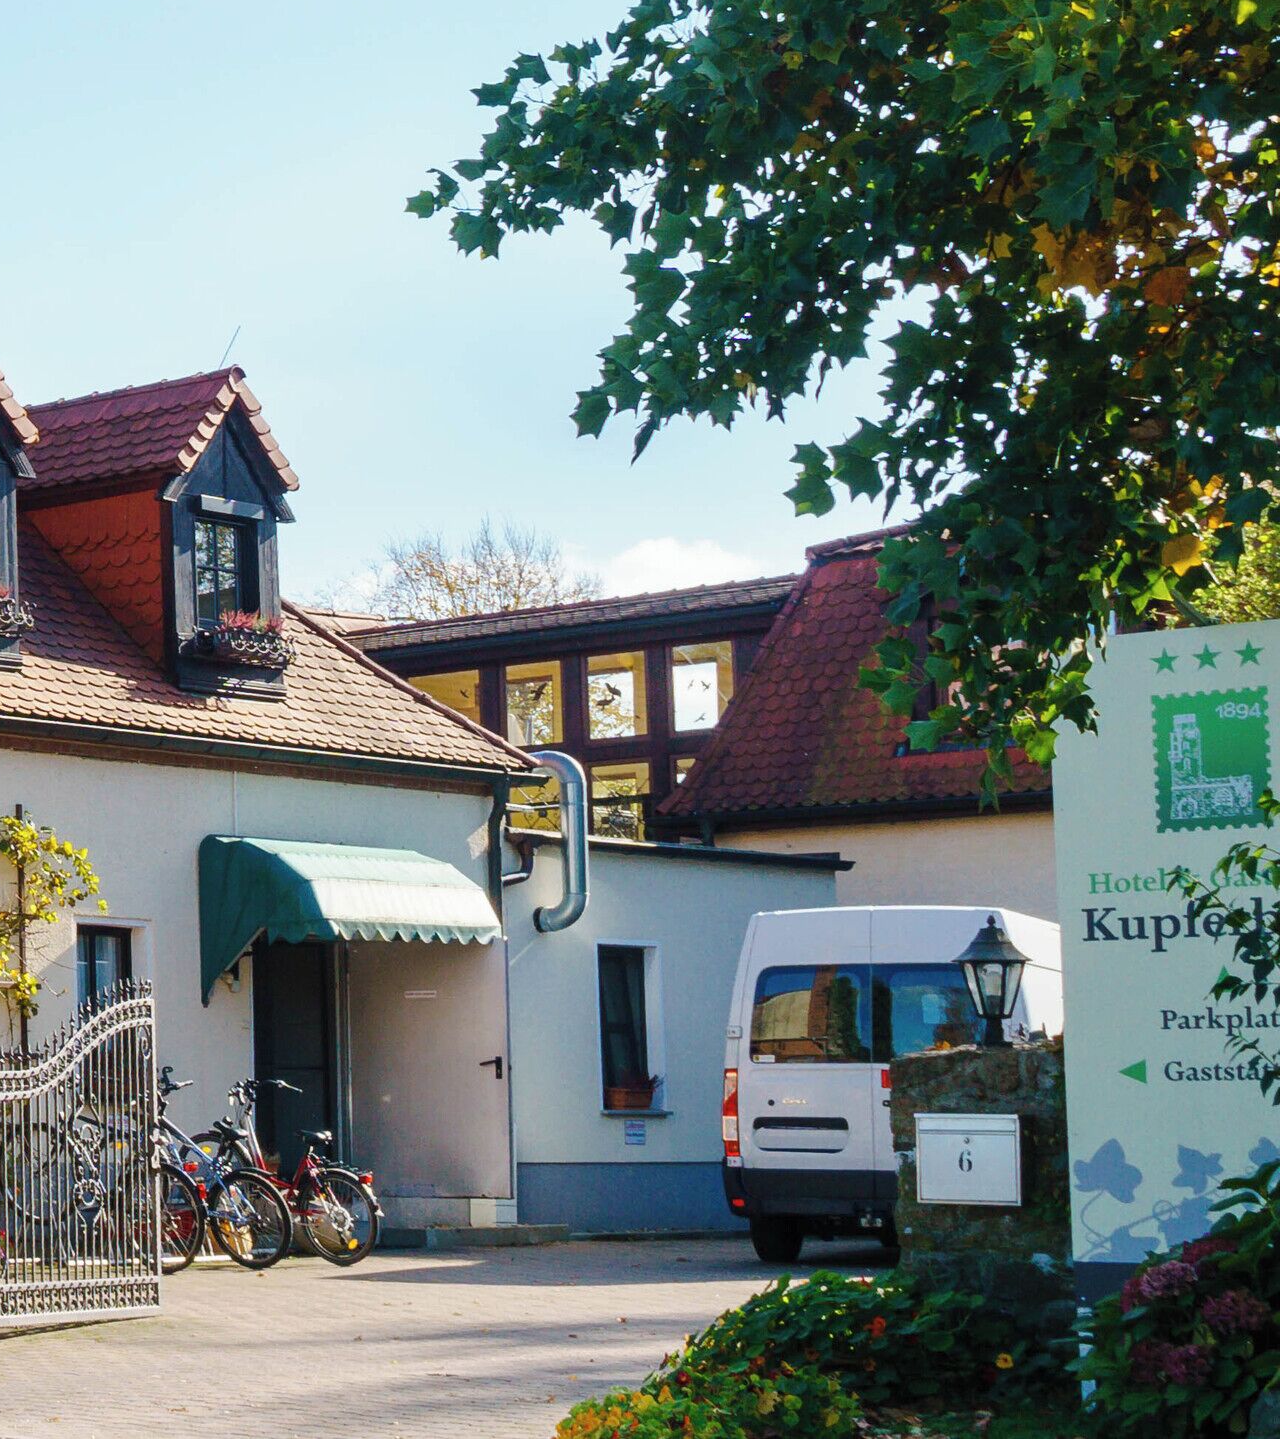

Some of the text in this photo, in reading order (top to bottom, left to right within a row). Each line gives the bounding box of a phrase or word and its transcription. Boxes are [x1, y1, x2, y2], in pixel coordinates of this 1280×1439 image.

[1215, 701, 1261, 720] 1894
[1088, 867, 1168, 894] Hotel
[1164, 1060, 1280, 1082] Gastst
[958, 1150, 973, 1173] 6
